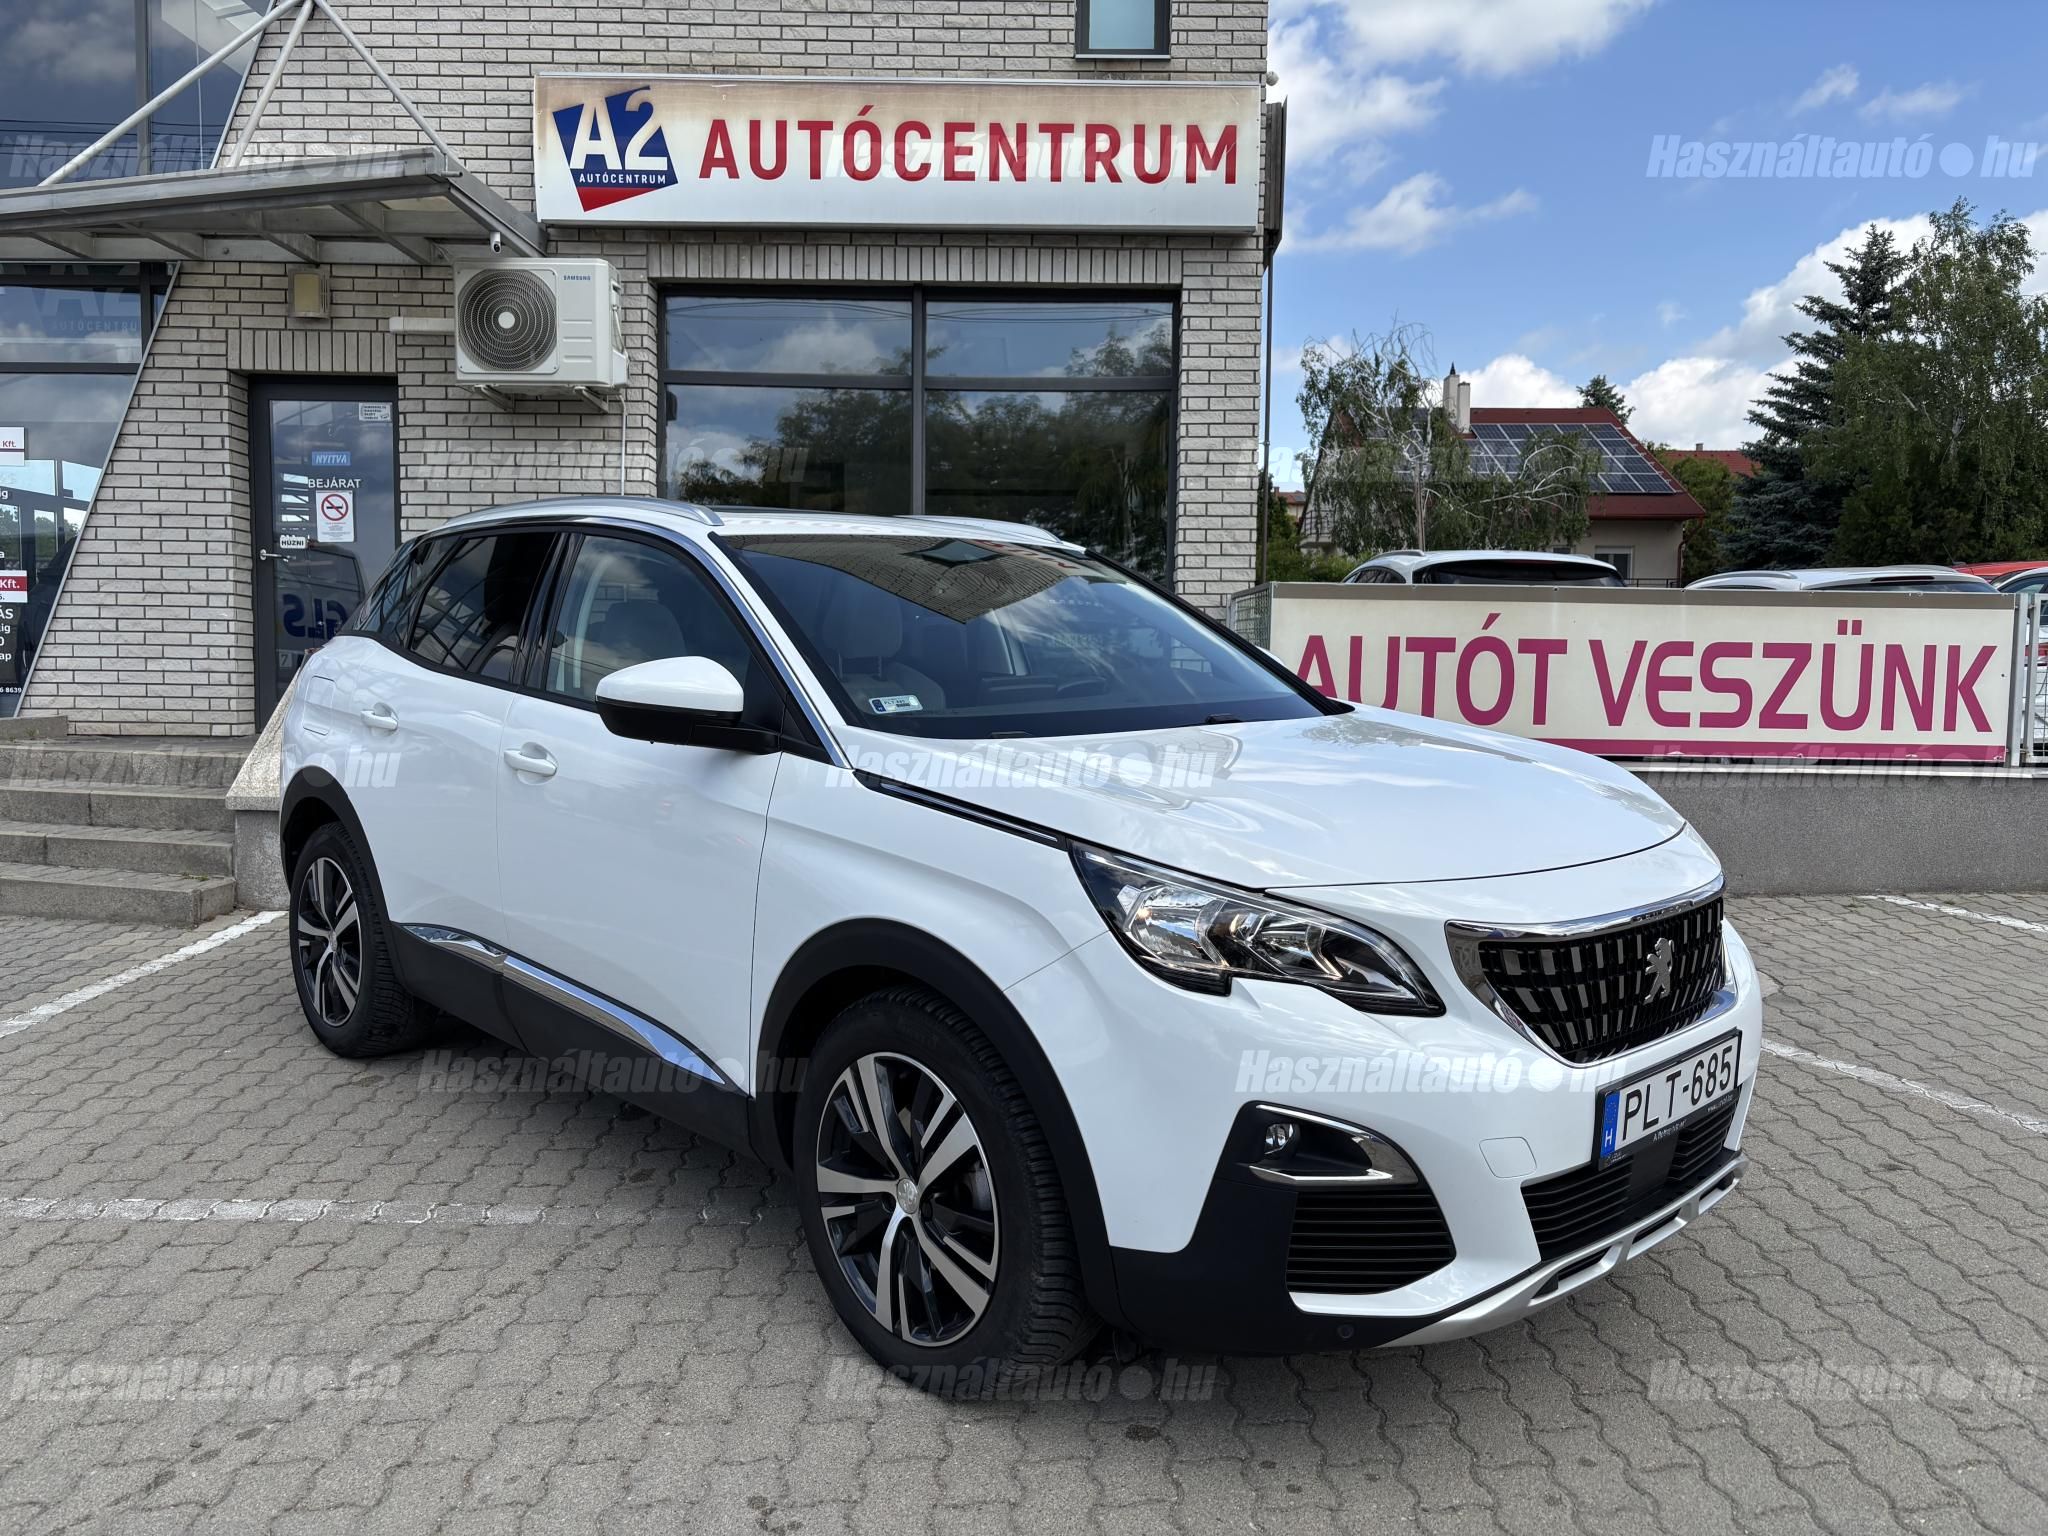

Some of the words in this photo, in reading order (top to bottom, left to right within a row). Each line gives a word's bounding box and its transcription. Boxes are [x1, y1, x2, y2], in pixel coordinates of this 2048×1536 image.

[569, 86, 668, 171] A2
[699, 104, 1238, 185] AUTÓCENTRUM
[579, 171, 667, 185] AUTÓCENTRUM
[2, 440, 17, 448] Kft.
[315, 454, 348, 465] NYITVA
[308, 476, 362, 489] BEJÁRAT
[0, 578, 20, 589] Kft.
[1296, 612, 1568, 726] AUTÓT
[1588, 618, 1998, 733] VESZÜNK
[1622, 1045, 1733, 1141] PLT-685
[1604, 1127, 1613, 1148] H
